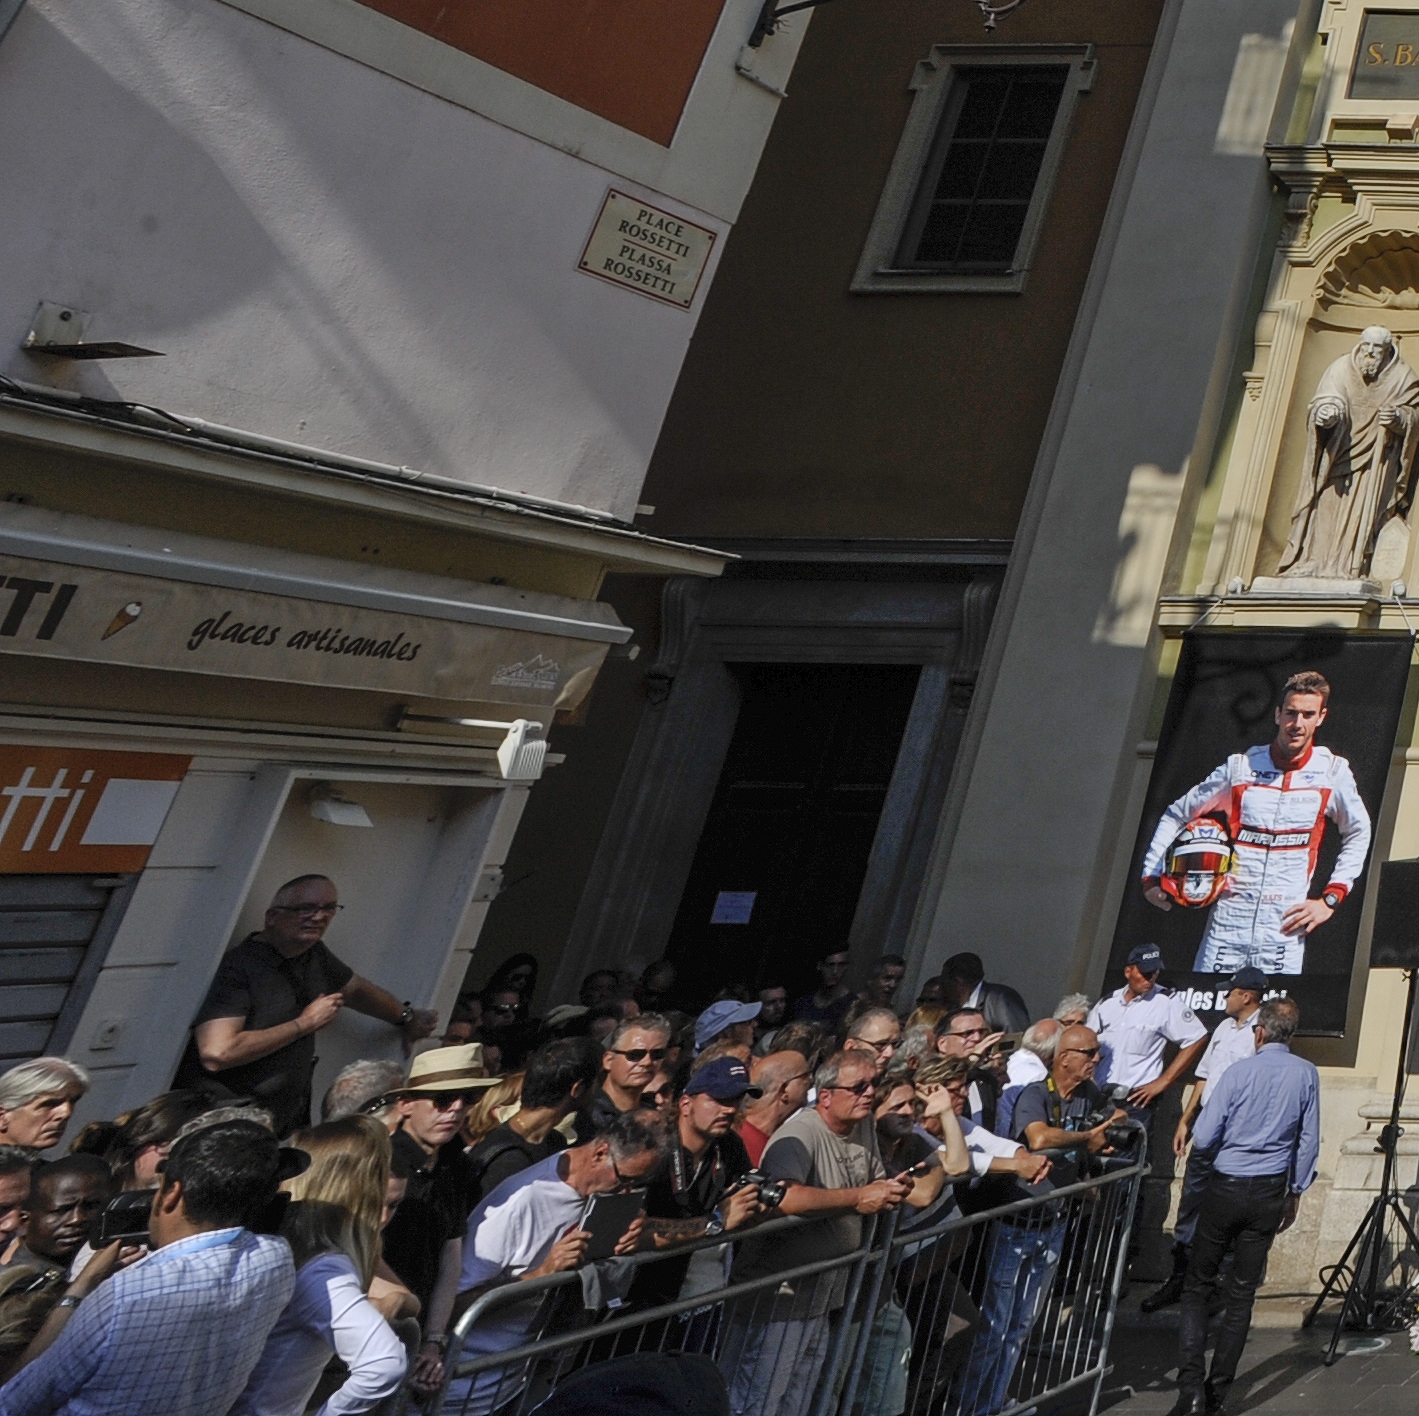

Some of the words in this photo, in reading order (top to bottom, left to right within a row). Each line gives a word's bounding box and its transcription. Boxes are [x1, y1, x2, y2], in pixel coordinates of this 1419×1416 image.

[618, 219, 691, 258] ROSSETTI
[636, 208, 685, 238] PLACE
[602, 257, 676, 295] ROSSETTI
[618, 244, 672, 276] PLASSA
[0, 574, 79, 641] TI
[186, 610, 281, 651] glaces
[286, 628, 421, 662] artisanales
